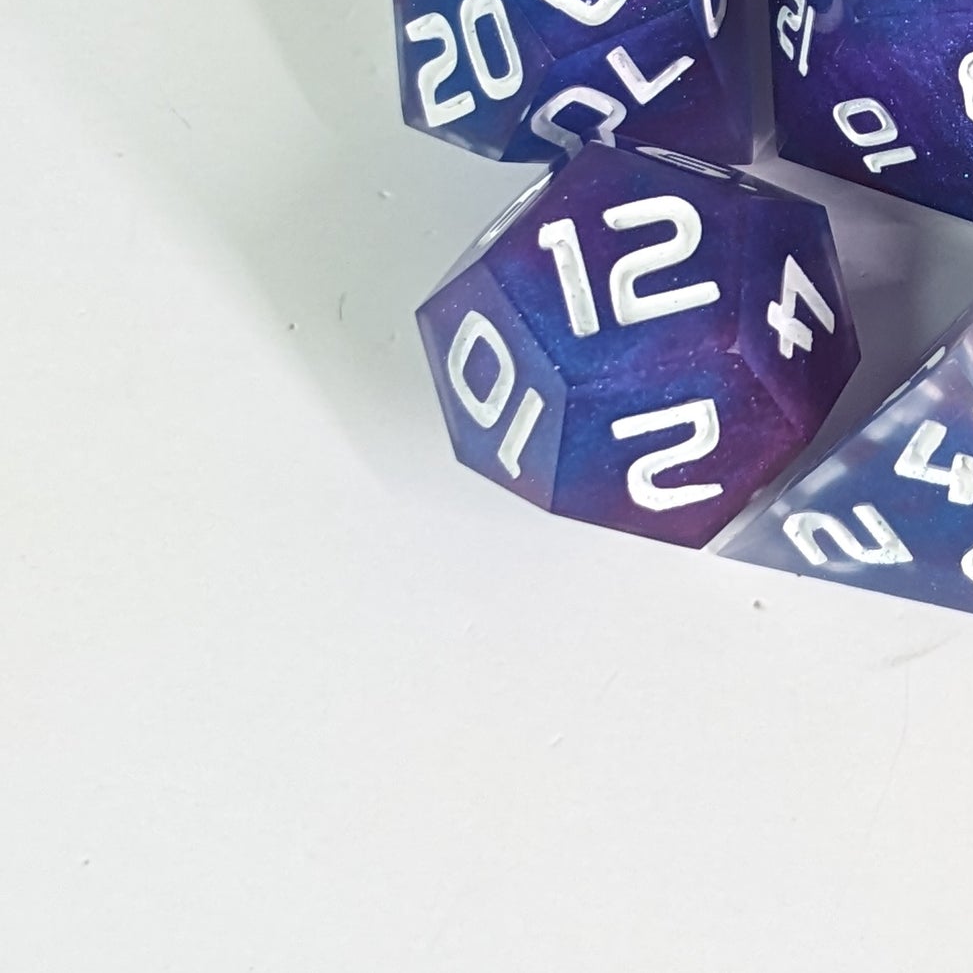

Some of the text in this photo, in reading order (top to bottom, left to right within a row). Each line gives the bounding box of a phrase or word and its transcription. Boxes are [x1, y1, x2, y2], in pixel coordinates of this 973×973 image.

[832, 97, 918, 174] 10
[538, 195, 721, 337] 12
[767, 254, 835, 359] 4
[447, 310, 545, 480] 10
[611, 398, 724, 512] 2
[782, 503, 914, 567] 2
